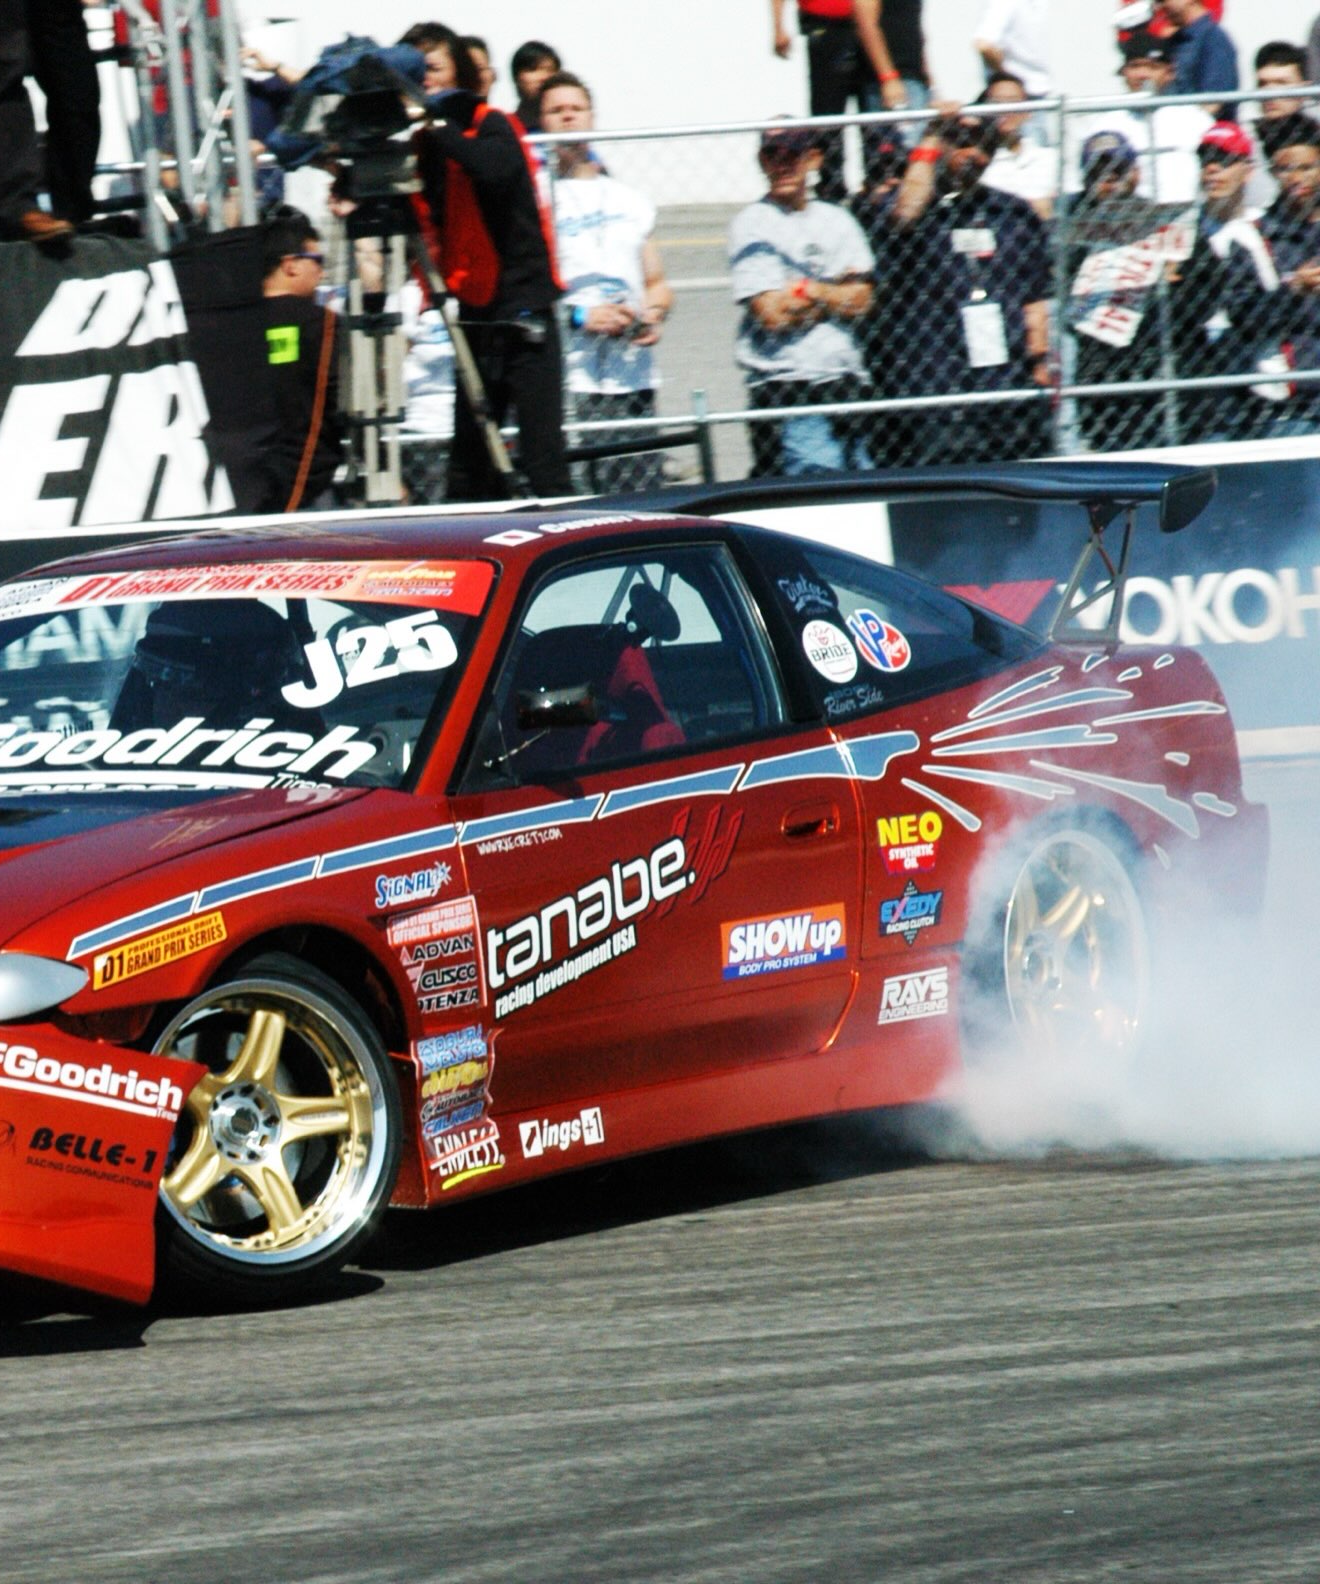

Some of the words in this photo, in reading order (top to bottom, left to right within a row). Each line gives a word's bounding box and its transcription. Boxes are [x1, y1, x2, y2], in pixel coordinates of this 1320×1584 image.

[281, 609, 459, 709] J25
[877, 811, 942, 847] NEO
[888, 843, 934, 861] SYNTHETIC
[487, 838, 695, 989] tanabe.
[880, 891, 942, 924] EXEDY
[127, 946, 161, 975] GRAND
[163, 939, 187, 961] PRIX
[188, 923, 224, 950] SERIES
[412, 932, 475, 962] ADVAN
[738, 962, 763, 976] BODY
[763, 959, 782, 971] PRO
[782, 953, 817, 968] SYSTEM
[421, 962, 477, 991] CUSCO
[495, 980, 535, 1019] racing
[535, 938, 612, 998] development
[612, 924, 637, 956] USA
[880, 972, 949, 1010] RAYS
[29, 1126, 158, 1174] BELLE-1
